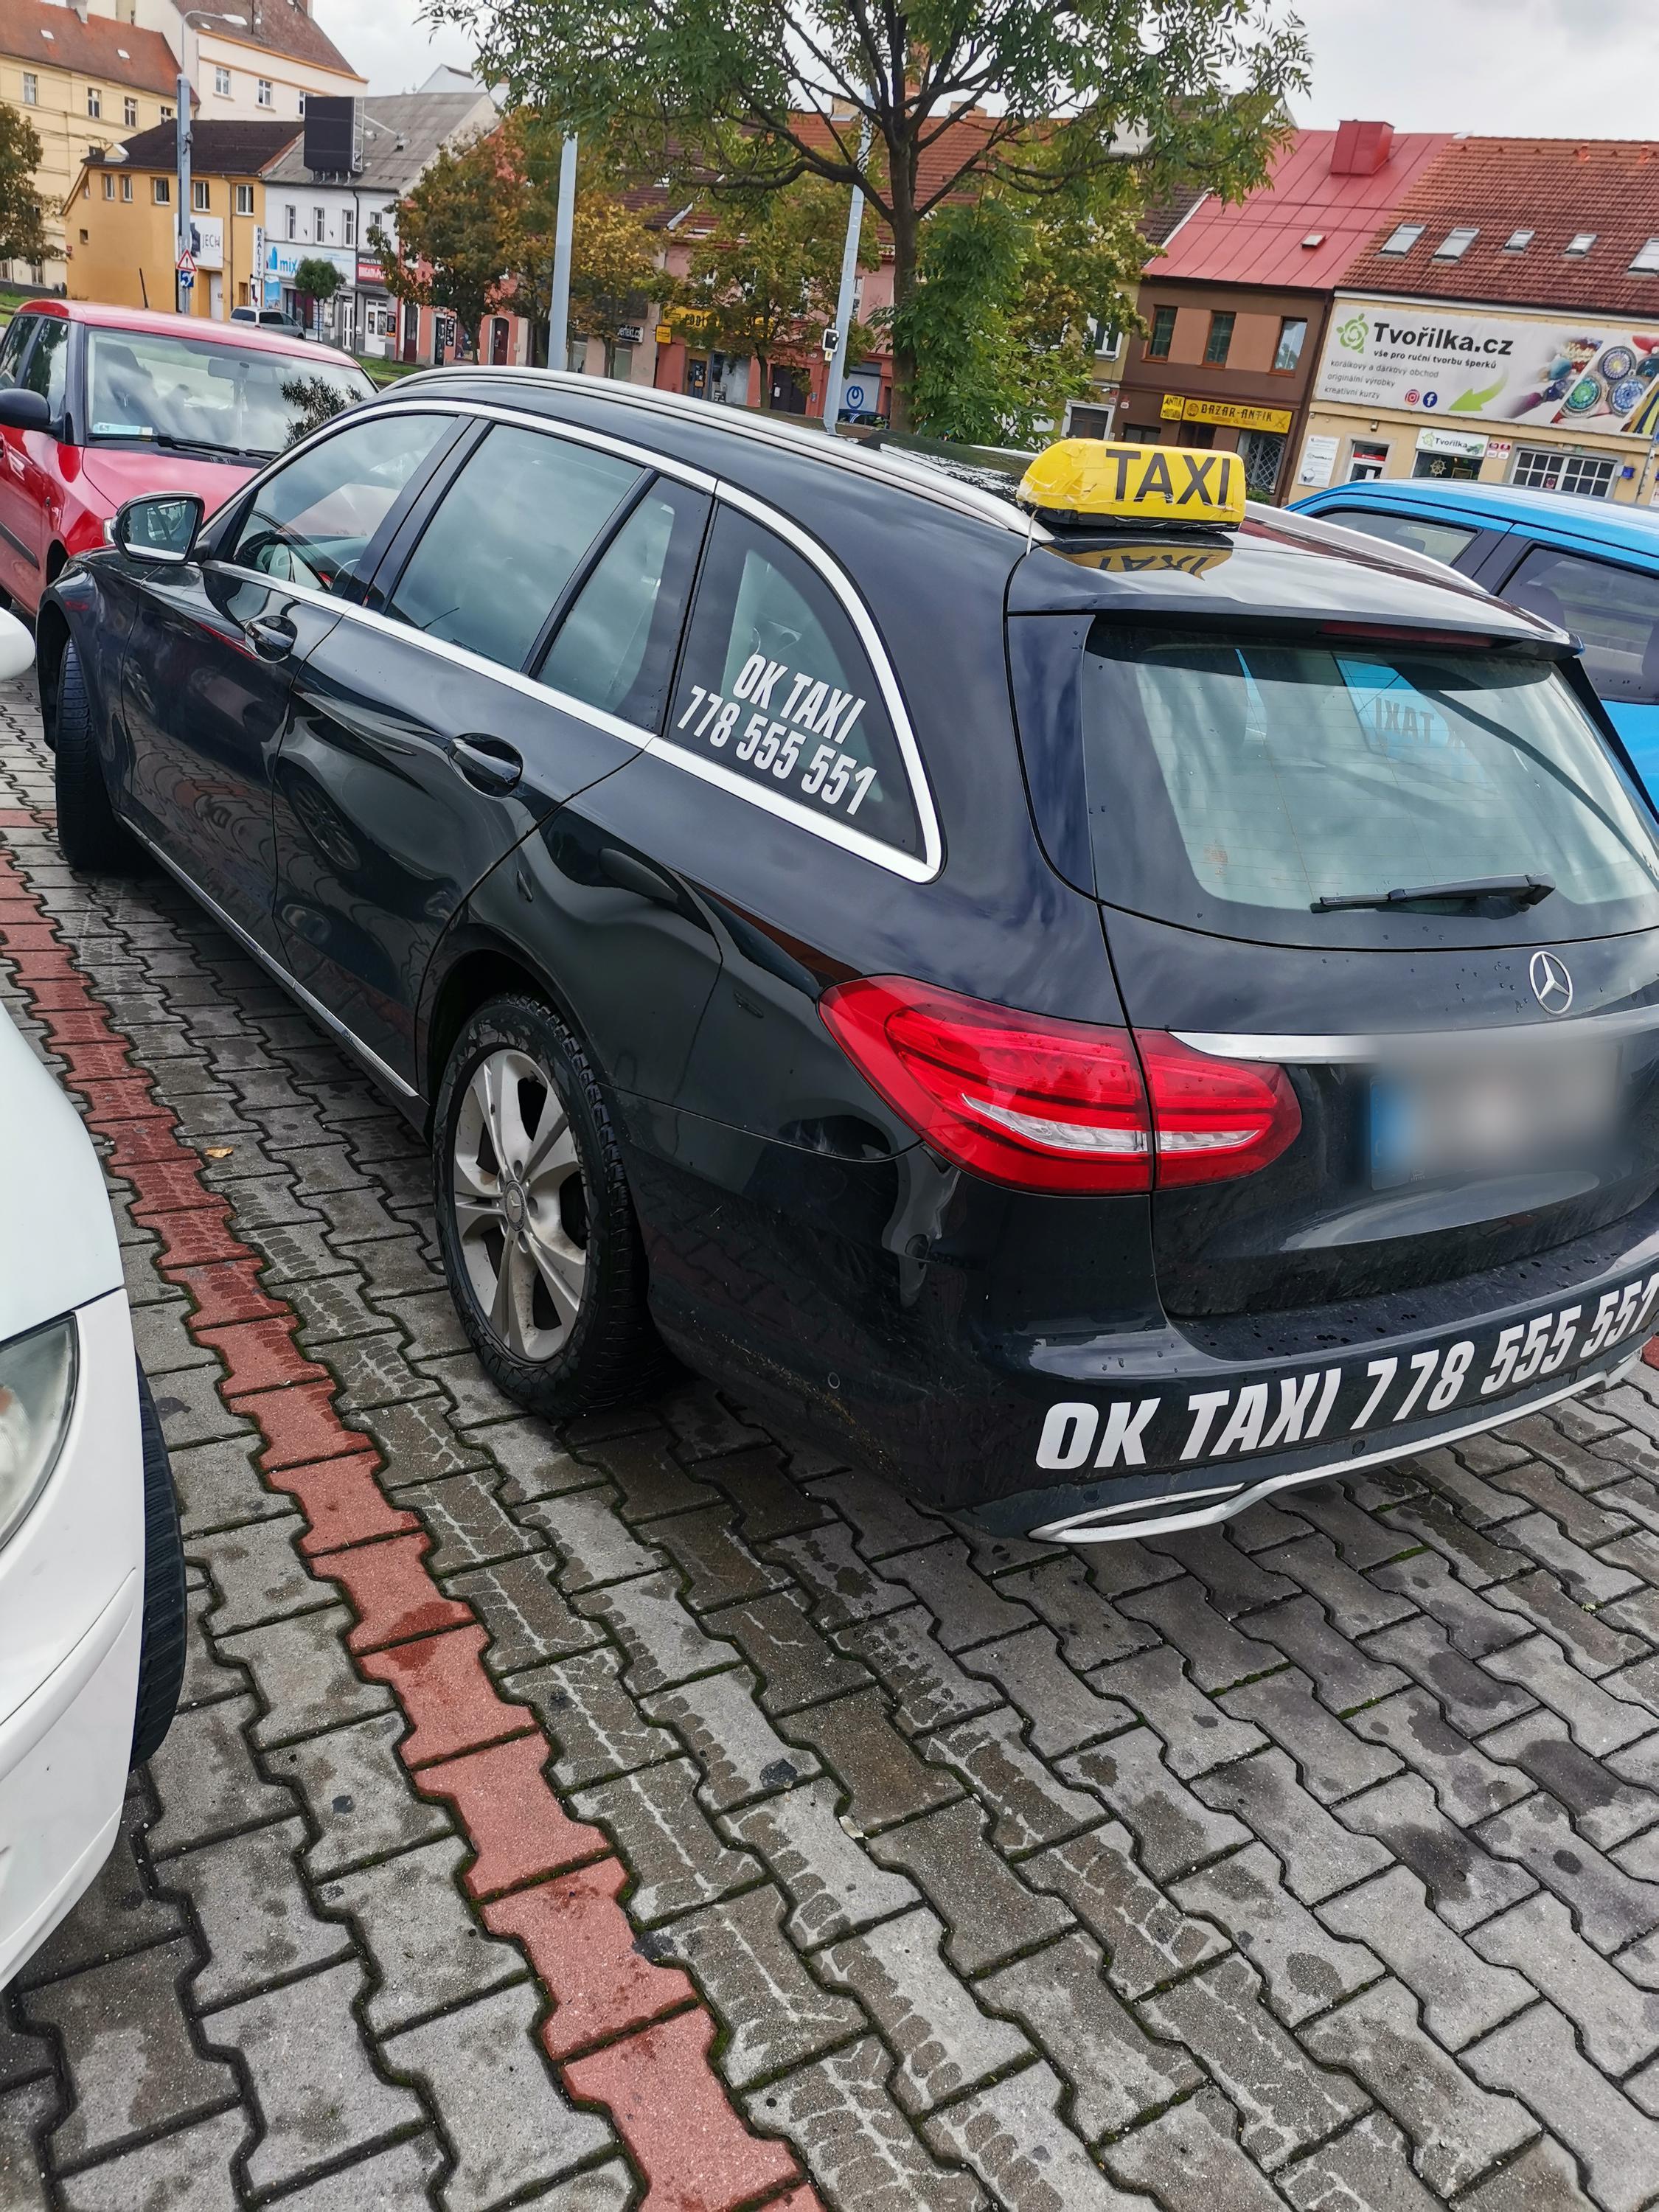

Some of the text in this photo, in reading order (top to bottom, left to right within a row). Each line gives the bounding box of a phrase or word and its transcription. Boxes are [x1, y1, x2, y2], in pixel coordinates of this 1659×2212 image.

[1374, 322, 1514, 355] Tvořilka.cz
[1374, 349, 1497, 369] vše pro ruční tvorbu šperků
[1327, 372, 1396, 388] originální výrobky
[1409, 369, 1439, 378] obchod
[1324, 386, 1380, 400] kreativní kurzy
[1200, 403, 1273, 422] BAZAR-ANTIK
[1435, 437, 1468, 448] Tvořilka
[1106, 448, 1231, 507] TAXI
[732, 654, 866, 745] OK TAXI
[677, 685, 877, 815] 778 555 551
[1035, 1398, 1159, 1470] OK
[1179, 1367, 1341, 1461] TAXI
[1481, 1304, 1582, 1395] 555
[1580, 1272, 1659, 1359] 551
